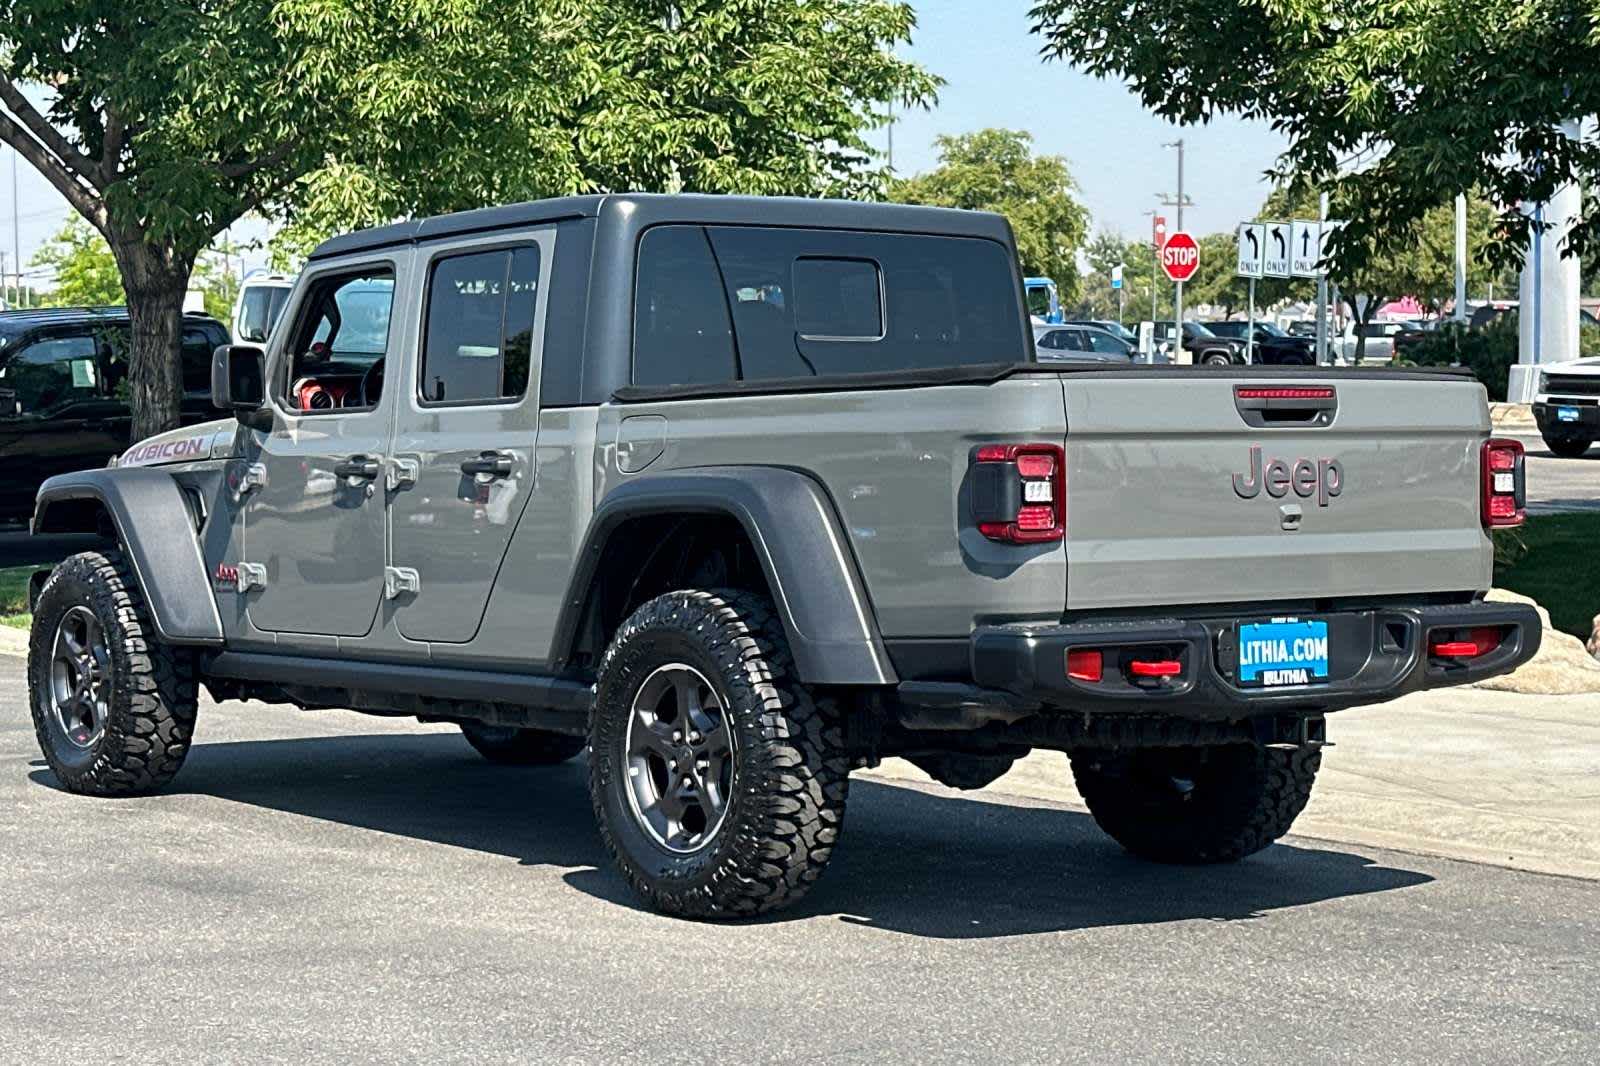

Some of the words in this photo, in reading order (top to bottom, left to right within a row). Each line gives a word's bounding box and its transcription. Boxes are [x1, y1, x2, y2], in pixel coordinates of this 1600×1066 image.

[1164, 246, 1197, 266] STOP
[1240, 261, 1260, 273] ONLY
[1266, 261, 1287, 273] ONLY
[1294, 260, 1314, 272] ONLY
[123, 438, 204, 464] RUBICON
[1232, 441, 1344, 507] Jeep
[1240, 637, 1328, 665] LITHIA.COM
[1273, 668, 1309, 686] LITHIA
